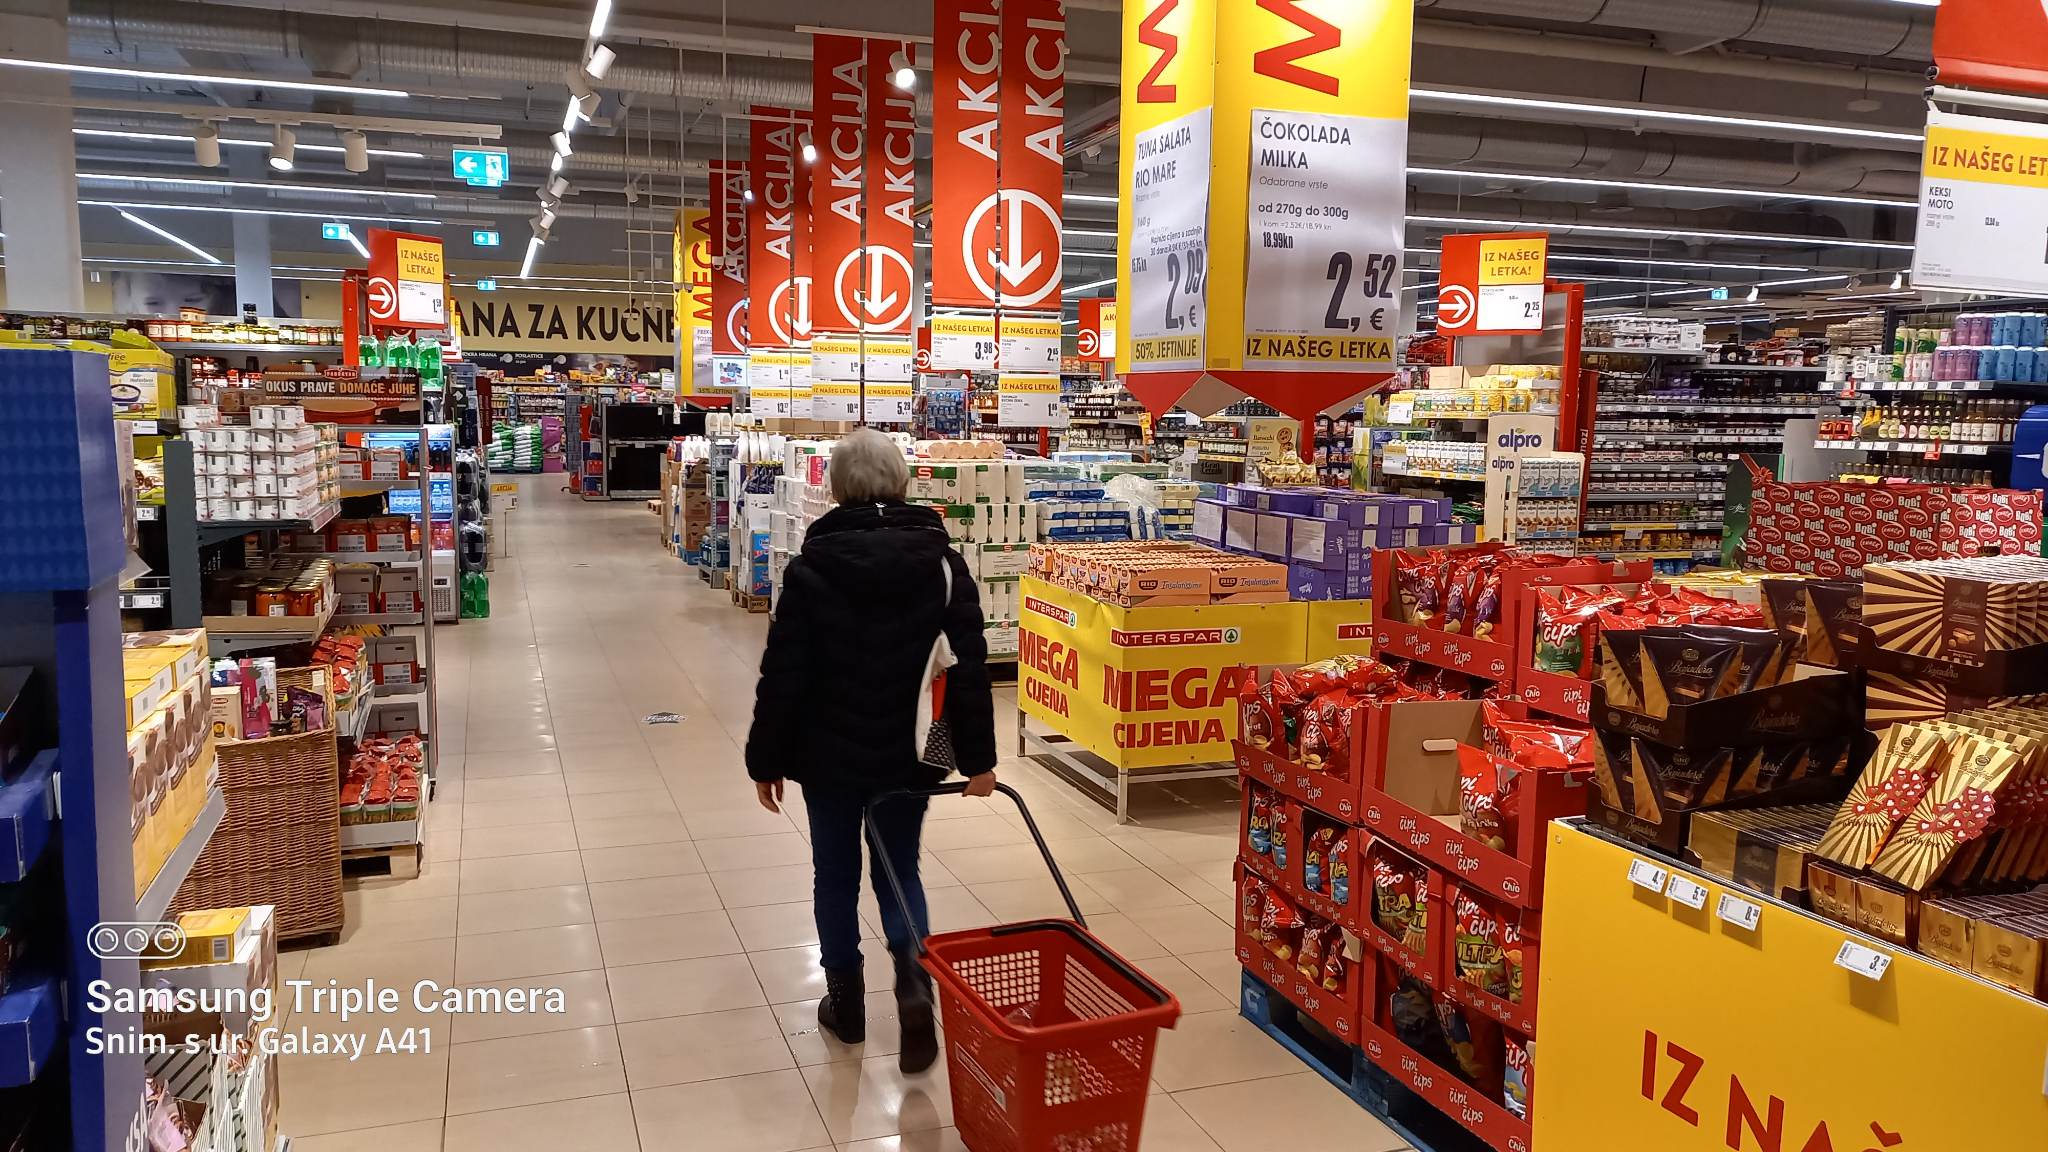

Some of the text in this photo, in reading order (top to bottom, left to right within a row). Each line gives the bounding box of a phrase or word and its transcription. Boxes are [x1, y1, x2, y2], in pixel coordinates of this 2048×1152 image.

[1260, 116, 1352, 146] ČOKOLADA
[831, 57, 864, 225] AKCIJA
[1138, 125, 1192, 161] TUNA SALATA
[1260, 148, 1309, 170] MILKA
[1933, 145, 2048, 177] IZ NAŠEG LET
[1135, 160, 1177, 189] RIO MARE
[1259, 175, 1329, 190] Odabrane vrste
[765, 125, 793, 261] AKCIJA
[1929, 186, 1952, 198] KEKSI
[1258, 203, 1350, 221] od 270g do 300g
[1928, 198, 1954, 210] MOTO
[1262, 231, 1294, 249] 18.99kn
[400, 249, 440, 263] IZ NAŠEG
[1484, 247, 1540, 262] IZ NAŠEG
[406, 263, 435, 275] LETKA!
[1490, 266, 1532, 277] LETKA!
[527, 303, 569, 340] ZA
[1103, 313, 1116, 321] AK
[1369, 307, 1385, 331] €
[934, 322, 993, 333] IZ NAŠEG LETKA!
[1010, 325, 1034, 335] NAŠEG
[1035, 328, 1059, 336] LETKA!
[1135, 338, 1197, 360] 50% JEFTINIJE
[1246, 335, 1391, 360] IZ NAŠEG LETKA
[265, 381, 296, 393] OKUS
[300, 381, 336, 393] PRAVE
[388, 382, 417, 395] JUHE
[1009, 382, 1033, 391] NAŠEG
[1034, 384, 1058, 392] LETKA!
[1497, 428, 1542, 452] alpro
[1492, 456, 1515, 472] alpro
[1028, 599, 1069, 624] INTERSPAR
[1116, 632, 1221, 645] INTERSPAR
[1018, 627, 1079, 691] MEGA
[1491, 661, 1505, 671] Chio
[1025, 676, 1069, 718] CIJENA
[1103, 664, 1258, 713] MEGA
[1525, 689, 1541, 698] Chio
[1113, 718, 1226, 749] CIJENA
[1339, 802, 1352, 812] Chio
[1367, 808, 1381, 820] Chio
[1399, 815, 1417, 833] čipi
[1410, 830, 1431, 848] čips
[1445, 838, 1465, 857] čipi
[1457, 854, 1480, 875] čips
[1502, 881, 1521, 894] Chio
[1336, 1019, 1349, 1031] Chio
[1368, 1042, 1382, 1054] Chio
[1401, 1055, 1419, 1072] čipi
[1413, 1070, 1433, 1092] čips
[1641, 1029, 1705, 1127] IZ
[1449, 1087, 1468, 1105] čipi
[1462, 1105, 1484, 1127] čips
[1508, 1138, 1526, 1152] Chio
